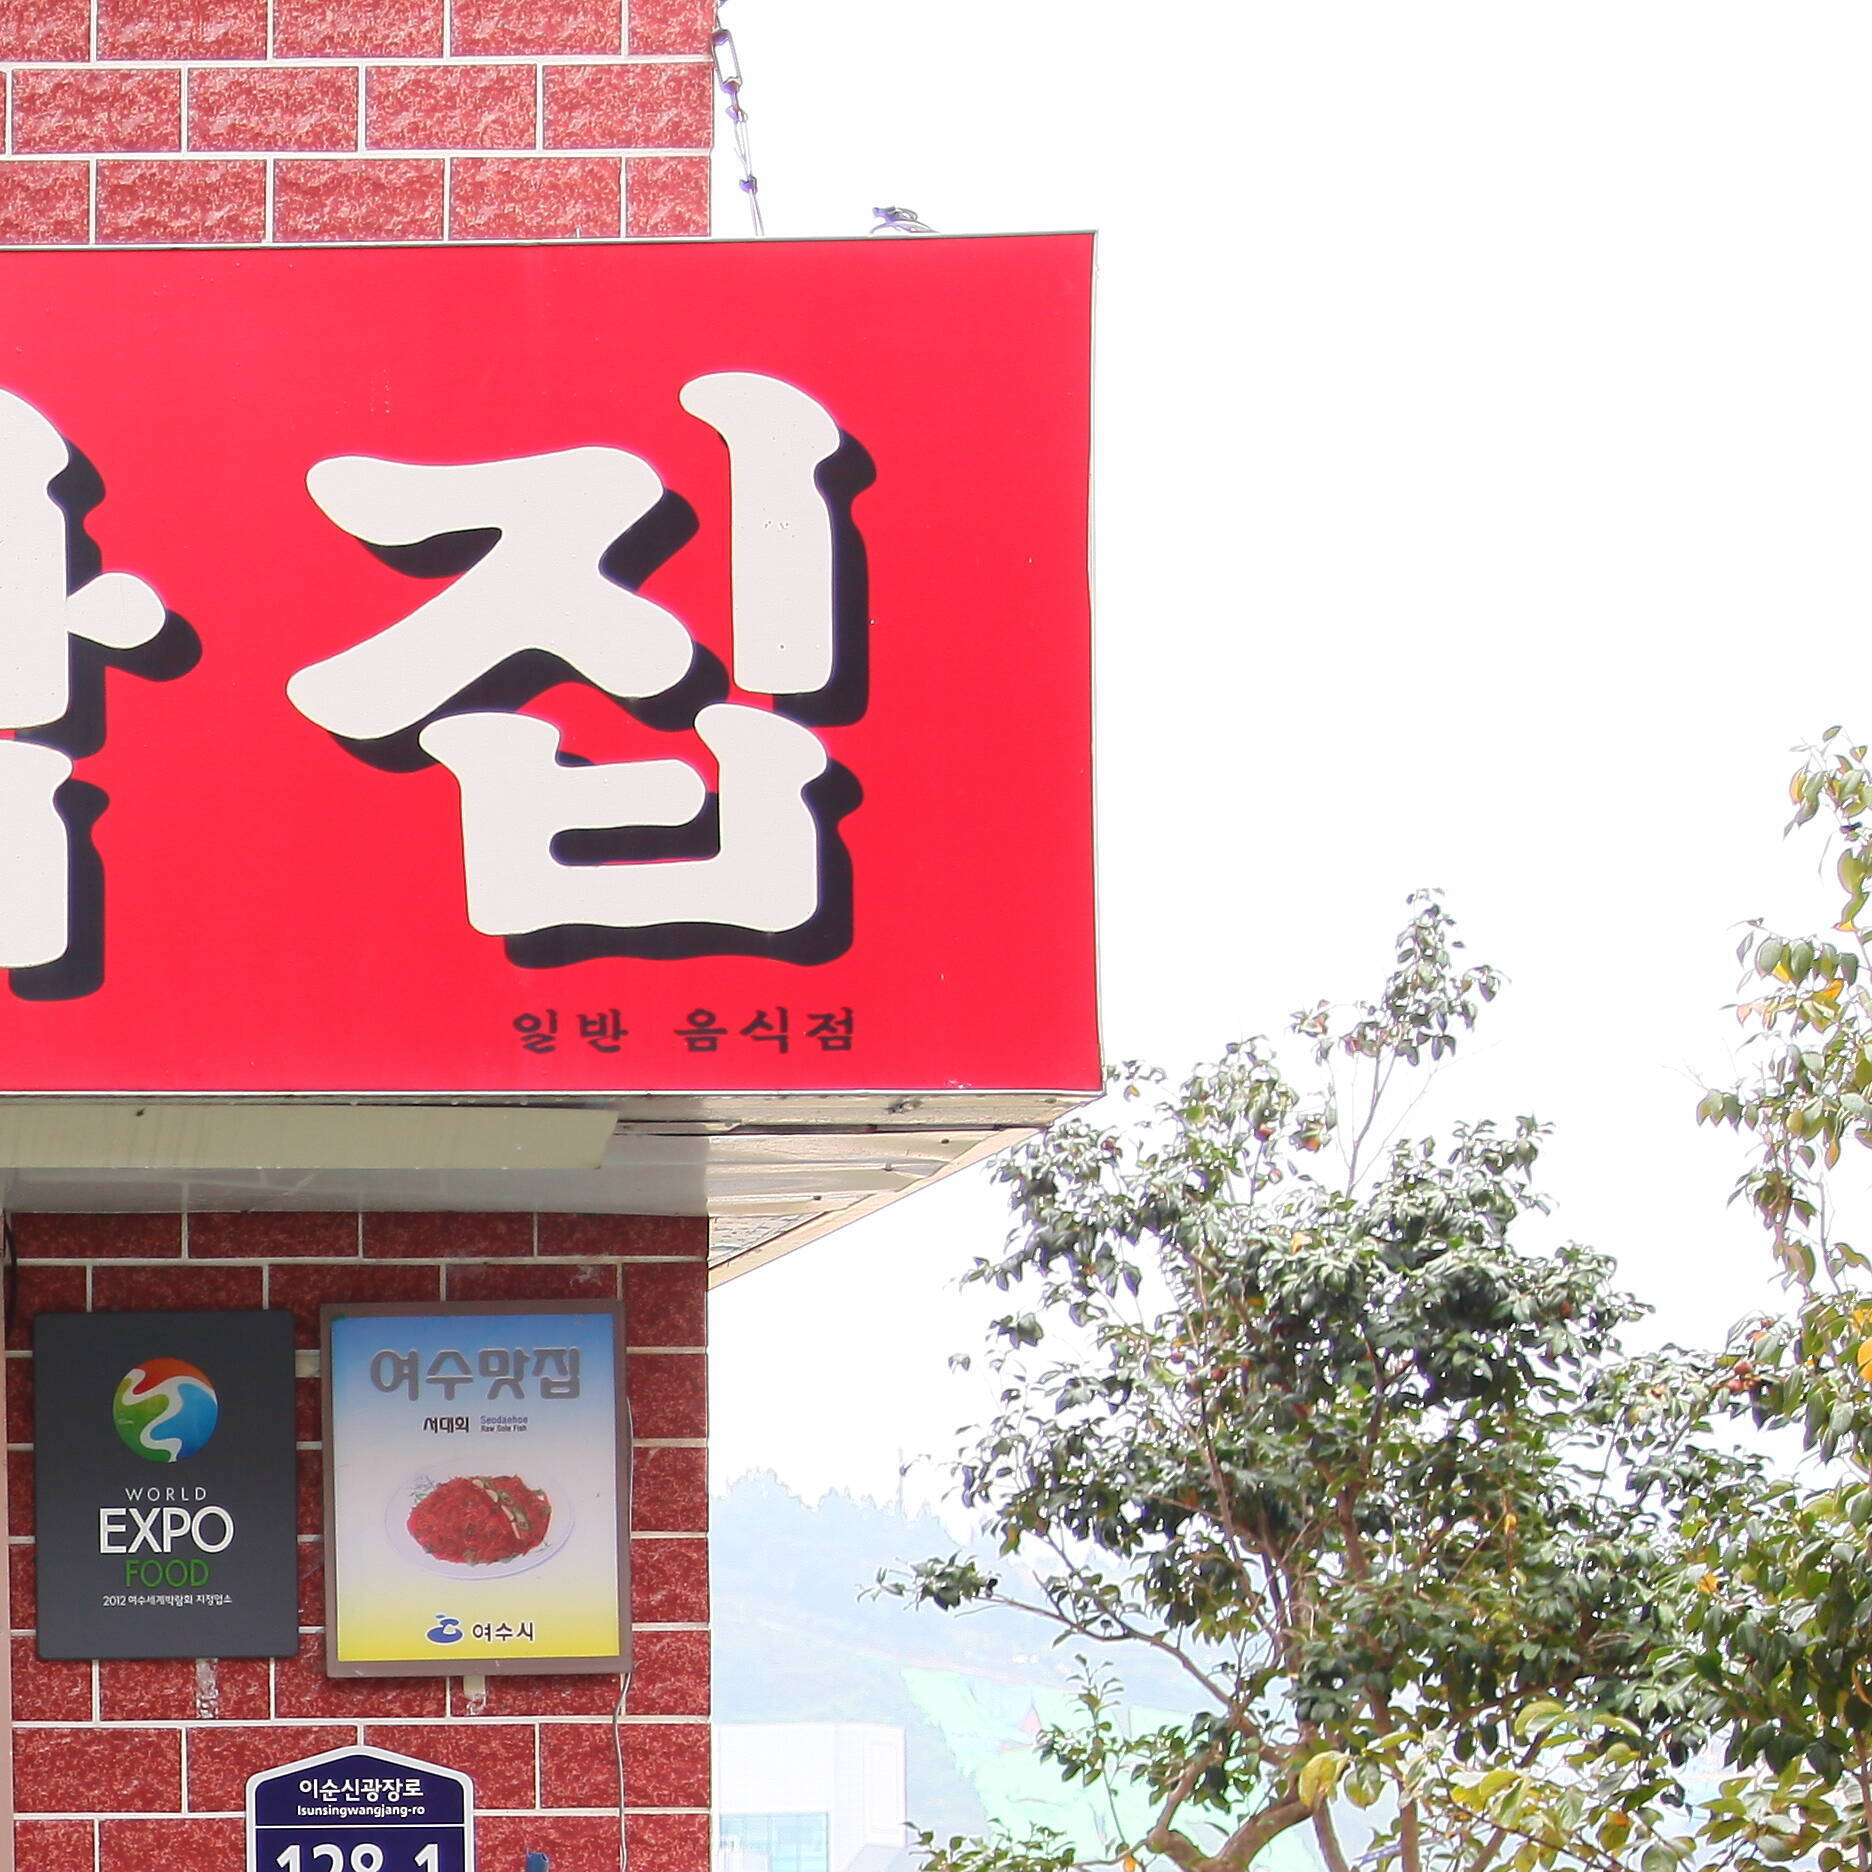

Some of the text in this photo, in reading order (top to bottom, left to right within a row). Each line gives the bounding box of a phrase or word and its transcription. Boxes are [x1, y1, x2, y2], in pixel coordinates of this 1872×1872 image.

[512, 1006, 855, 1054] 일반 음식점
[370, 1347, 581, 1401] 여수맛집
[125, 1487, 206, 1501] WORLD
[100, 1506, 234, 1553] EXPO
[125, 1559, 209, 1587] FOOD
[103, 1595, 126, 1606] 2012
[196, 1594, 232, 1606] 지정업소
[472, 1622, 534, 1642] 여수시
[299, 1778, 423, 1802] 이순신광장로
